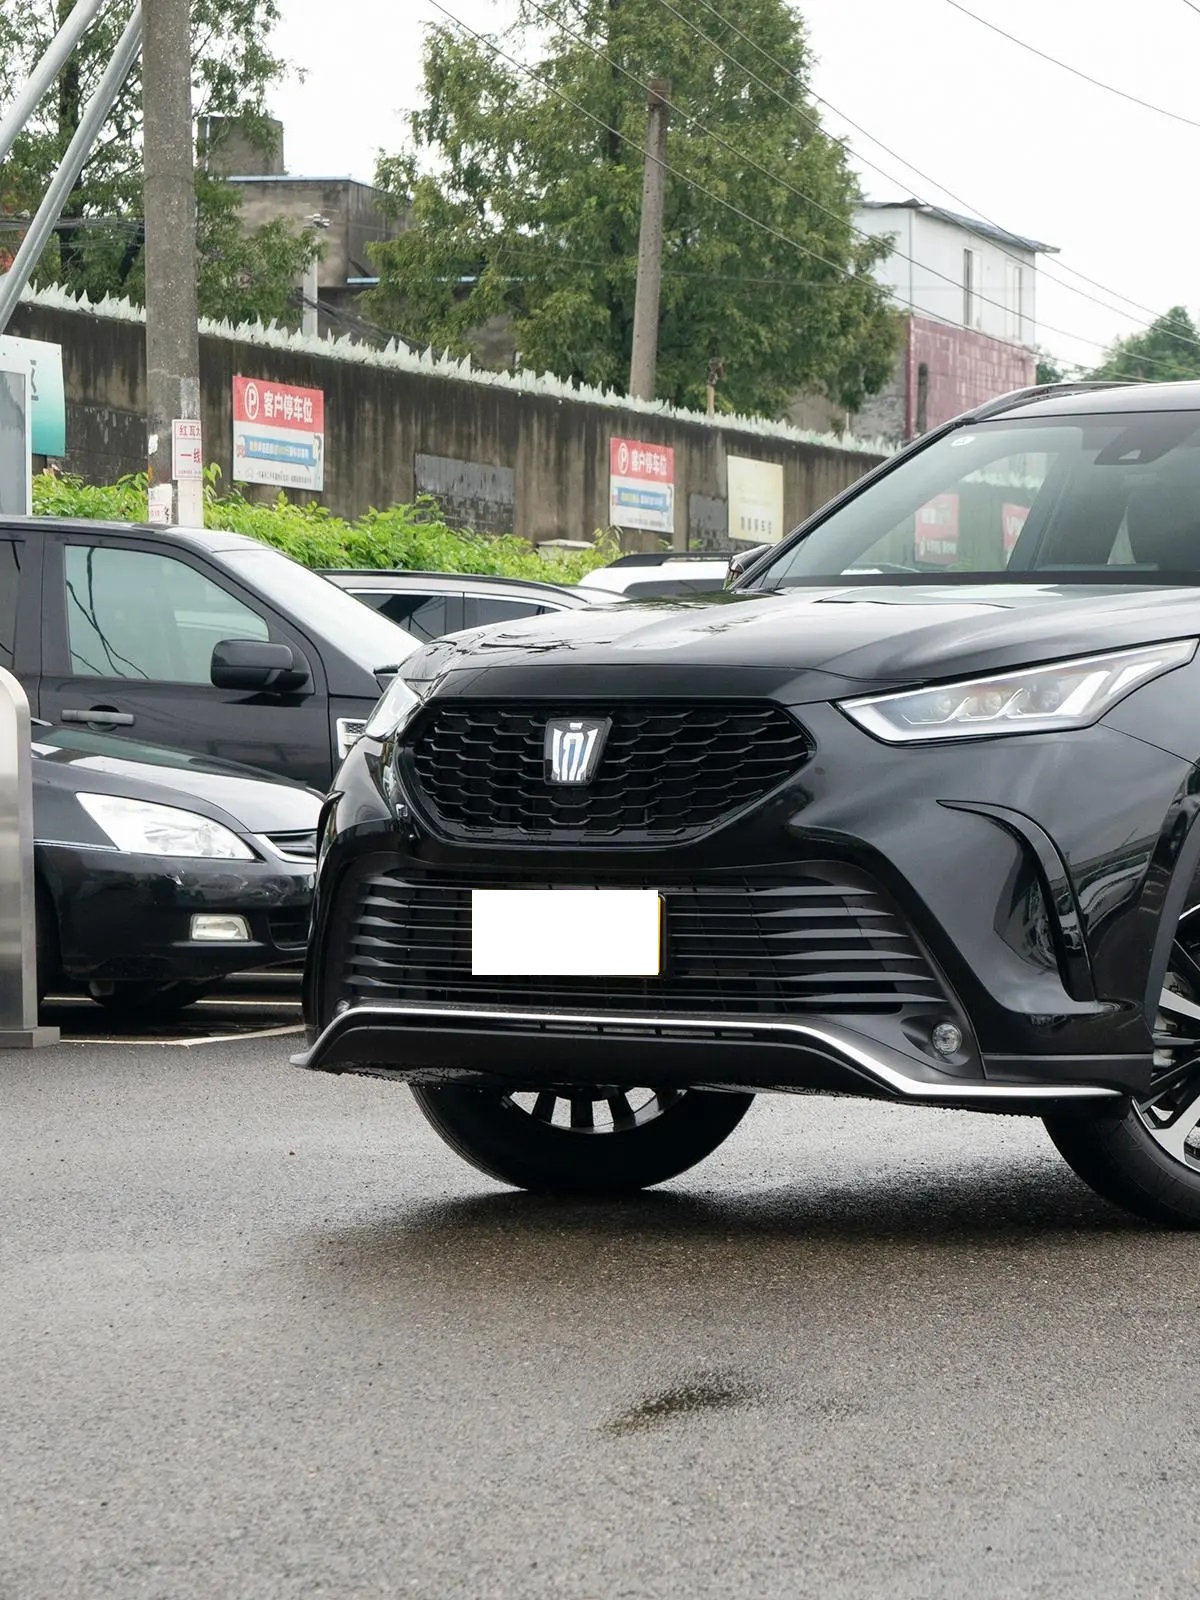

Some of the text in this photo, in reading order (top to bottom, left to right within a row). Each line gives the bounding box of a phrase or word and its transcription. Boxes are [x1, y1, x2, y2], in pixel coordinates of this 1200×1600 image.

[264, 391, 313, 423] 客户停车位
